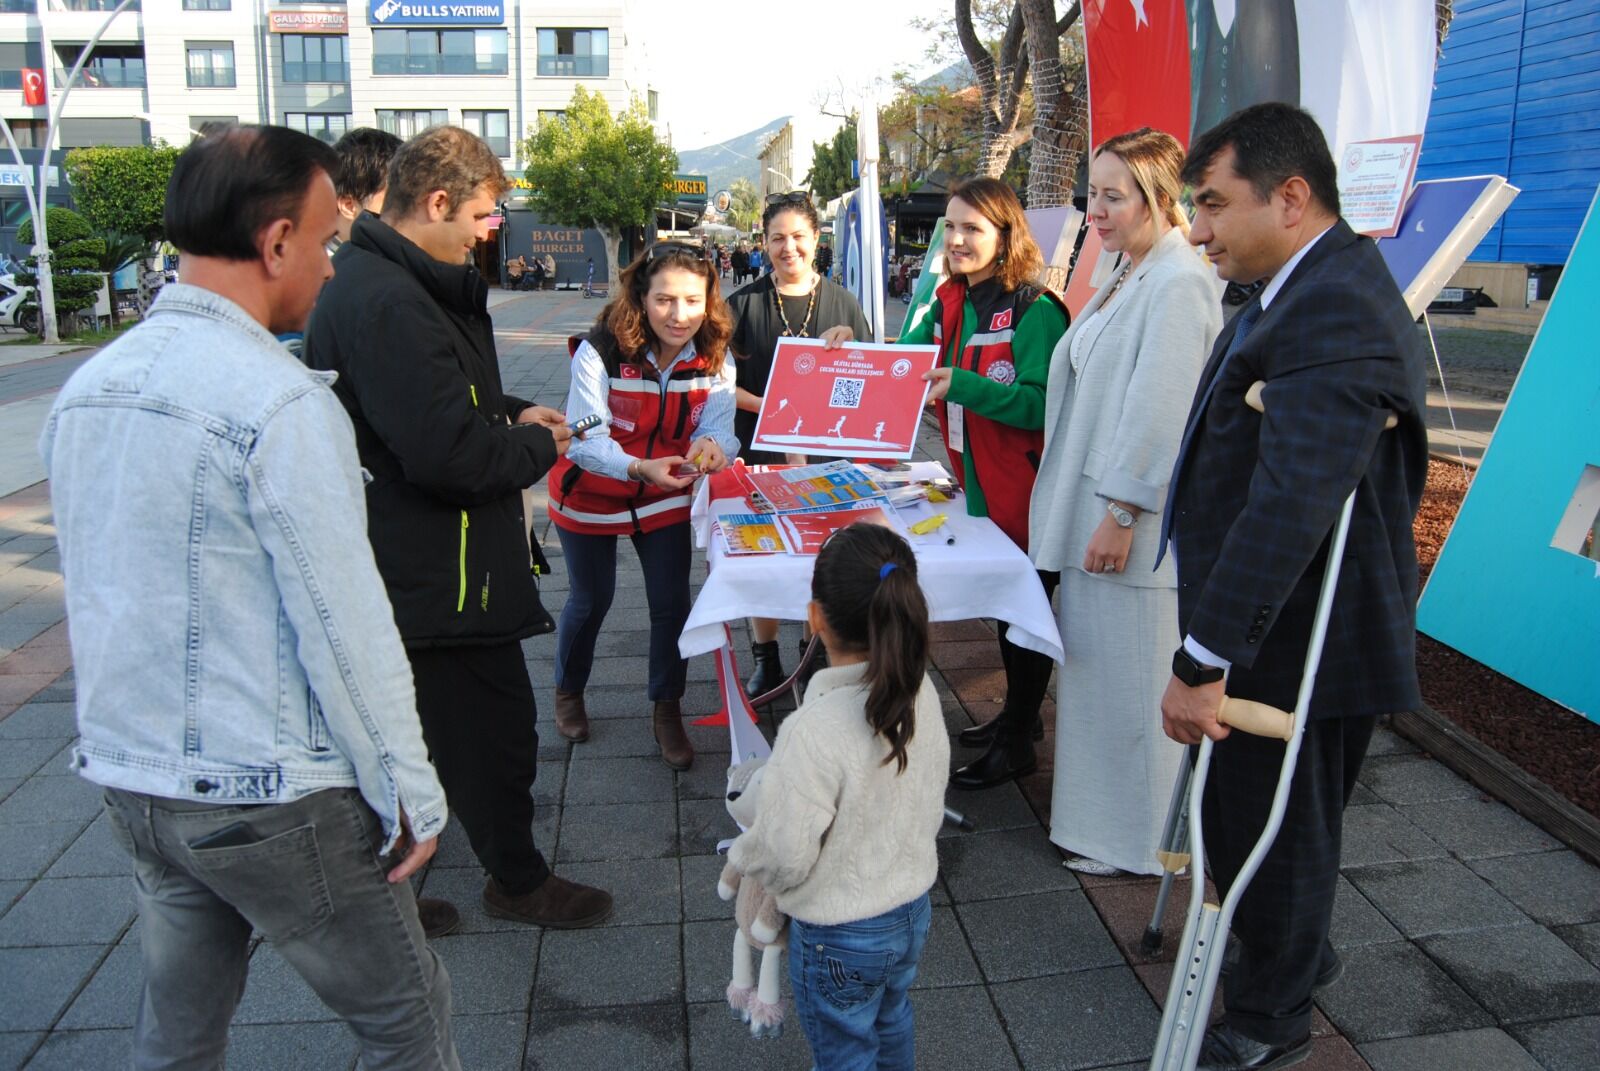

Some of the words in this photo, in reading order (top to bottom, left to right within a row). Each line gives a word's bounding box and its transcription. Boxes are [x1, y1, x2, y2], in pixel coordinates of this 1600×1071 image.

[402, 5, 448, 16] BULLS
[449, 6, 499, 16] YATIRIM
[532, 230, 584, 241] BAGET
[532, 244, 584, 253] BURGER
